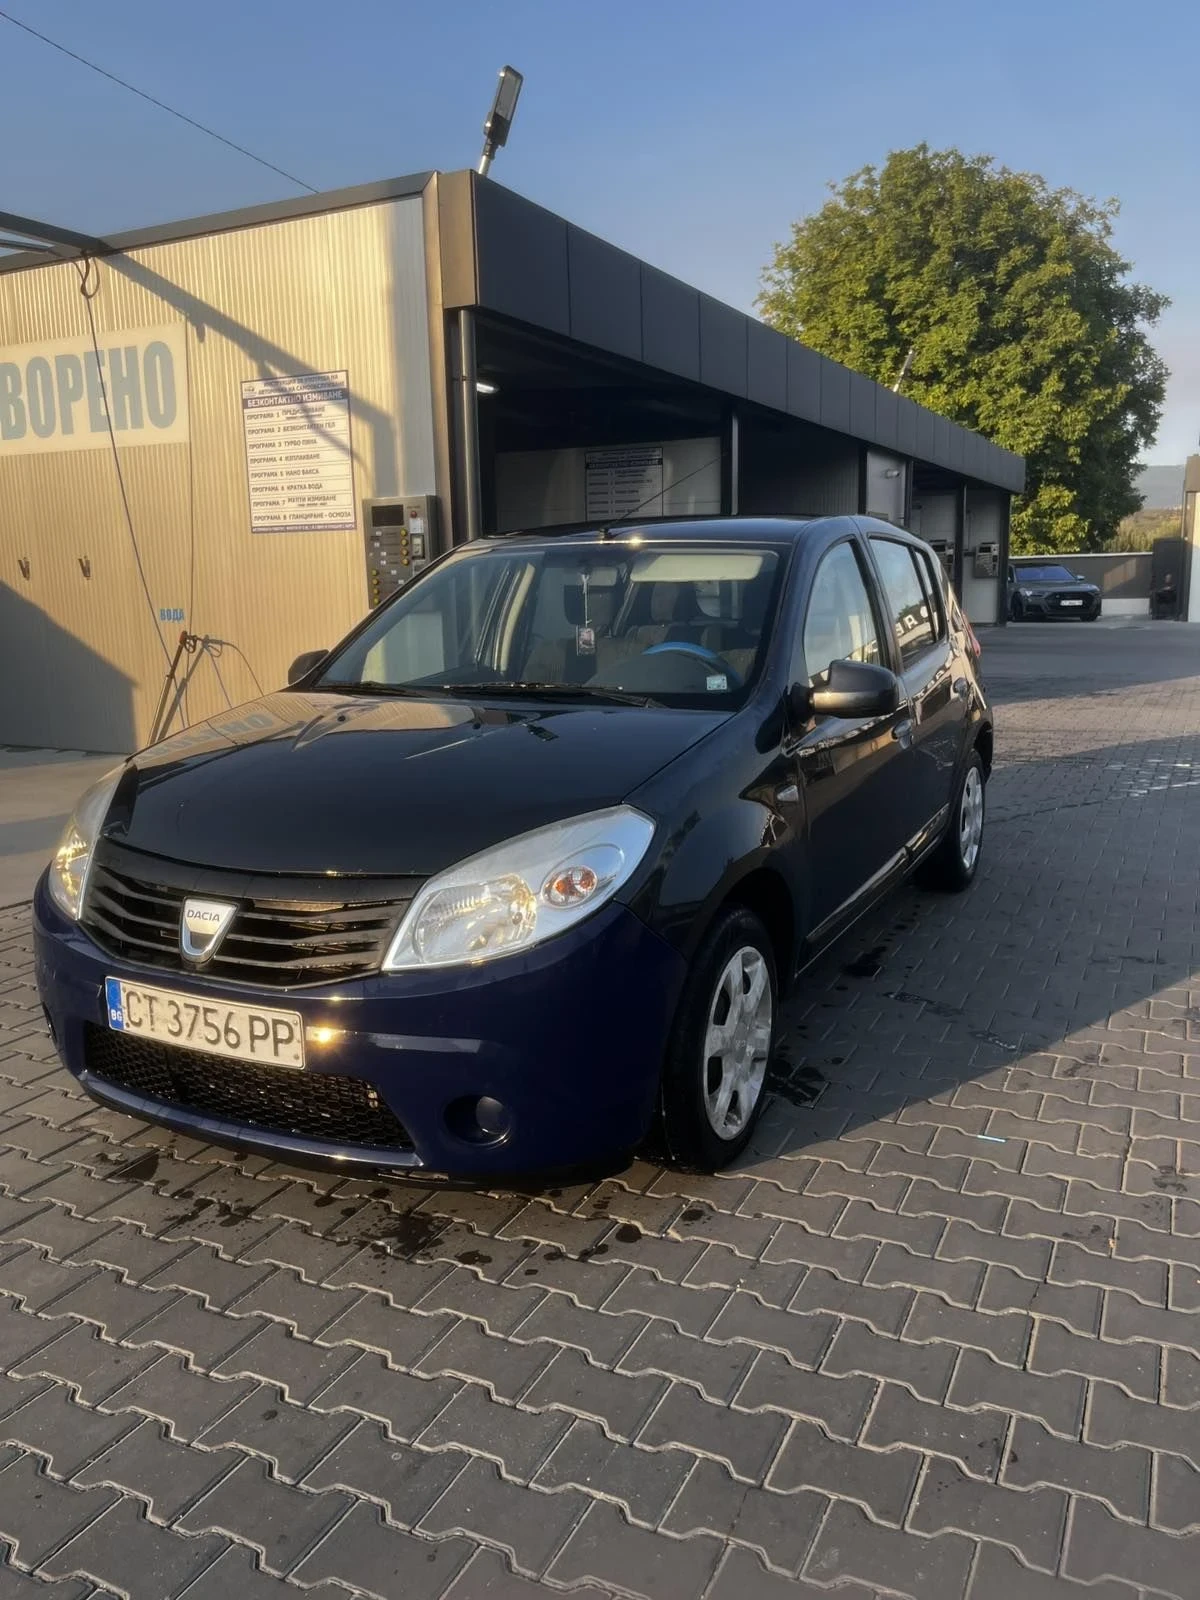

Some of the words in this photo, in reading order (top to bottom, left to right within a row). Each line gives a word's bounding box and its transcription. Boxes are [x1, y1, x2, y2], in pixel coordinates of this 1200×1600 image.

[0, 341, 177, 440] ВОРЕНО
[247, 394, 300, 408] БЕЗКОНТАКТНО
[302, 390, 343, 402] ИЗМИВАНЕ
[247, 412, 274, 420] ПРОГРАМА
[248, 427, 274, 435] ПРОГРАМА
[186, 909, 220, 922] DACIA
[110, 1009, 123, 1022] BG
[126, 991, 158, 1031] CT
[168, 1002, 240, 1050] 3756
[248, 1014, 294, 1056] PP
